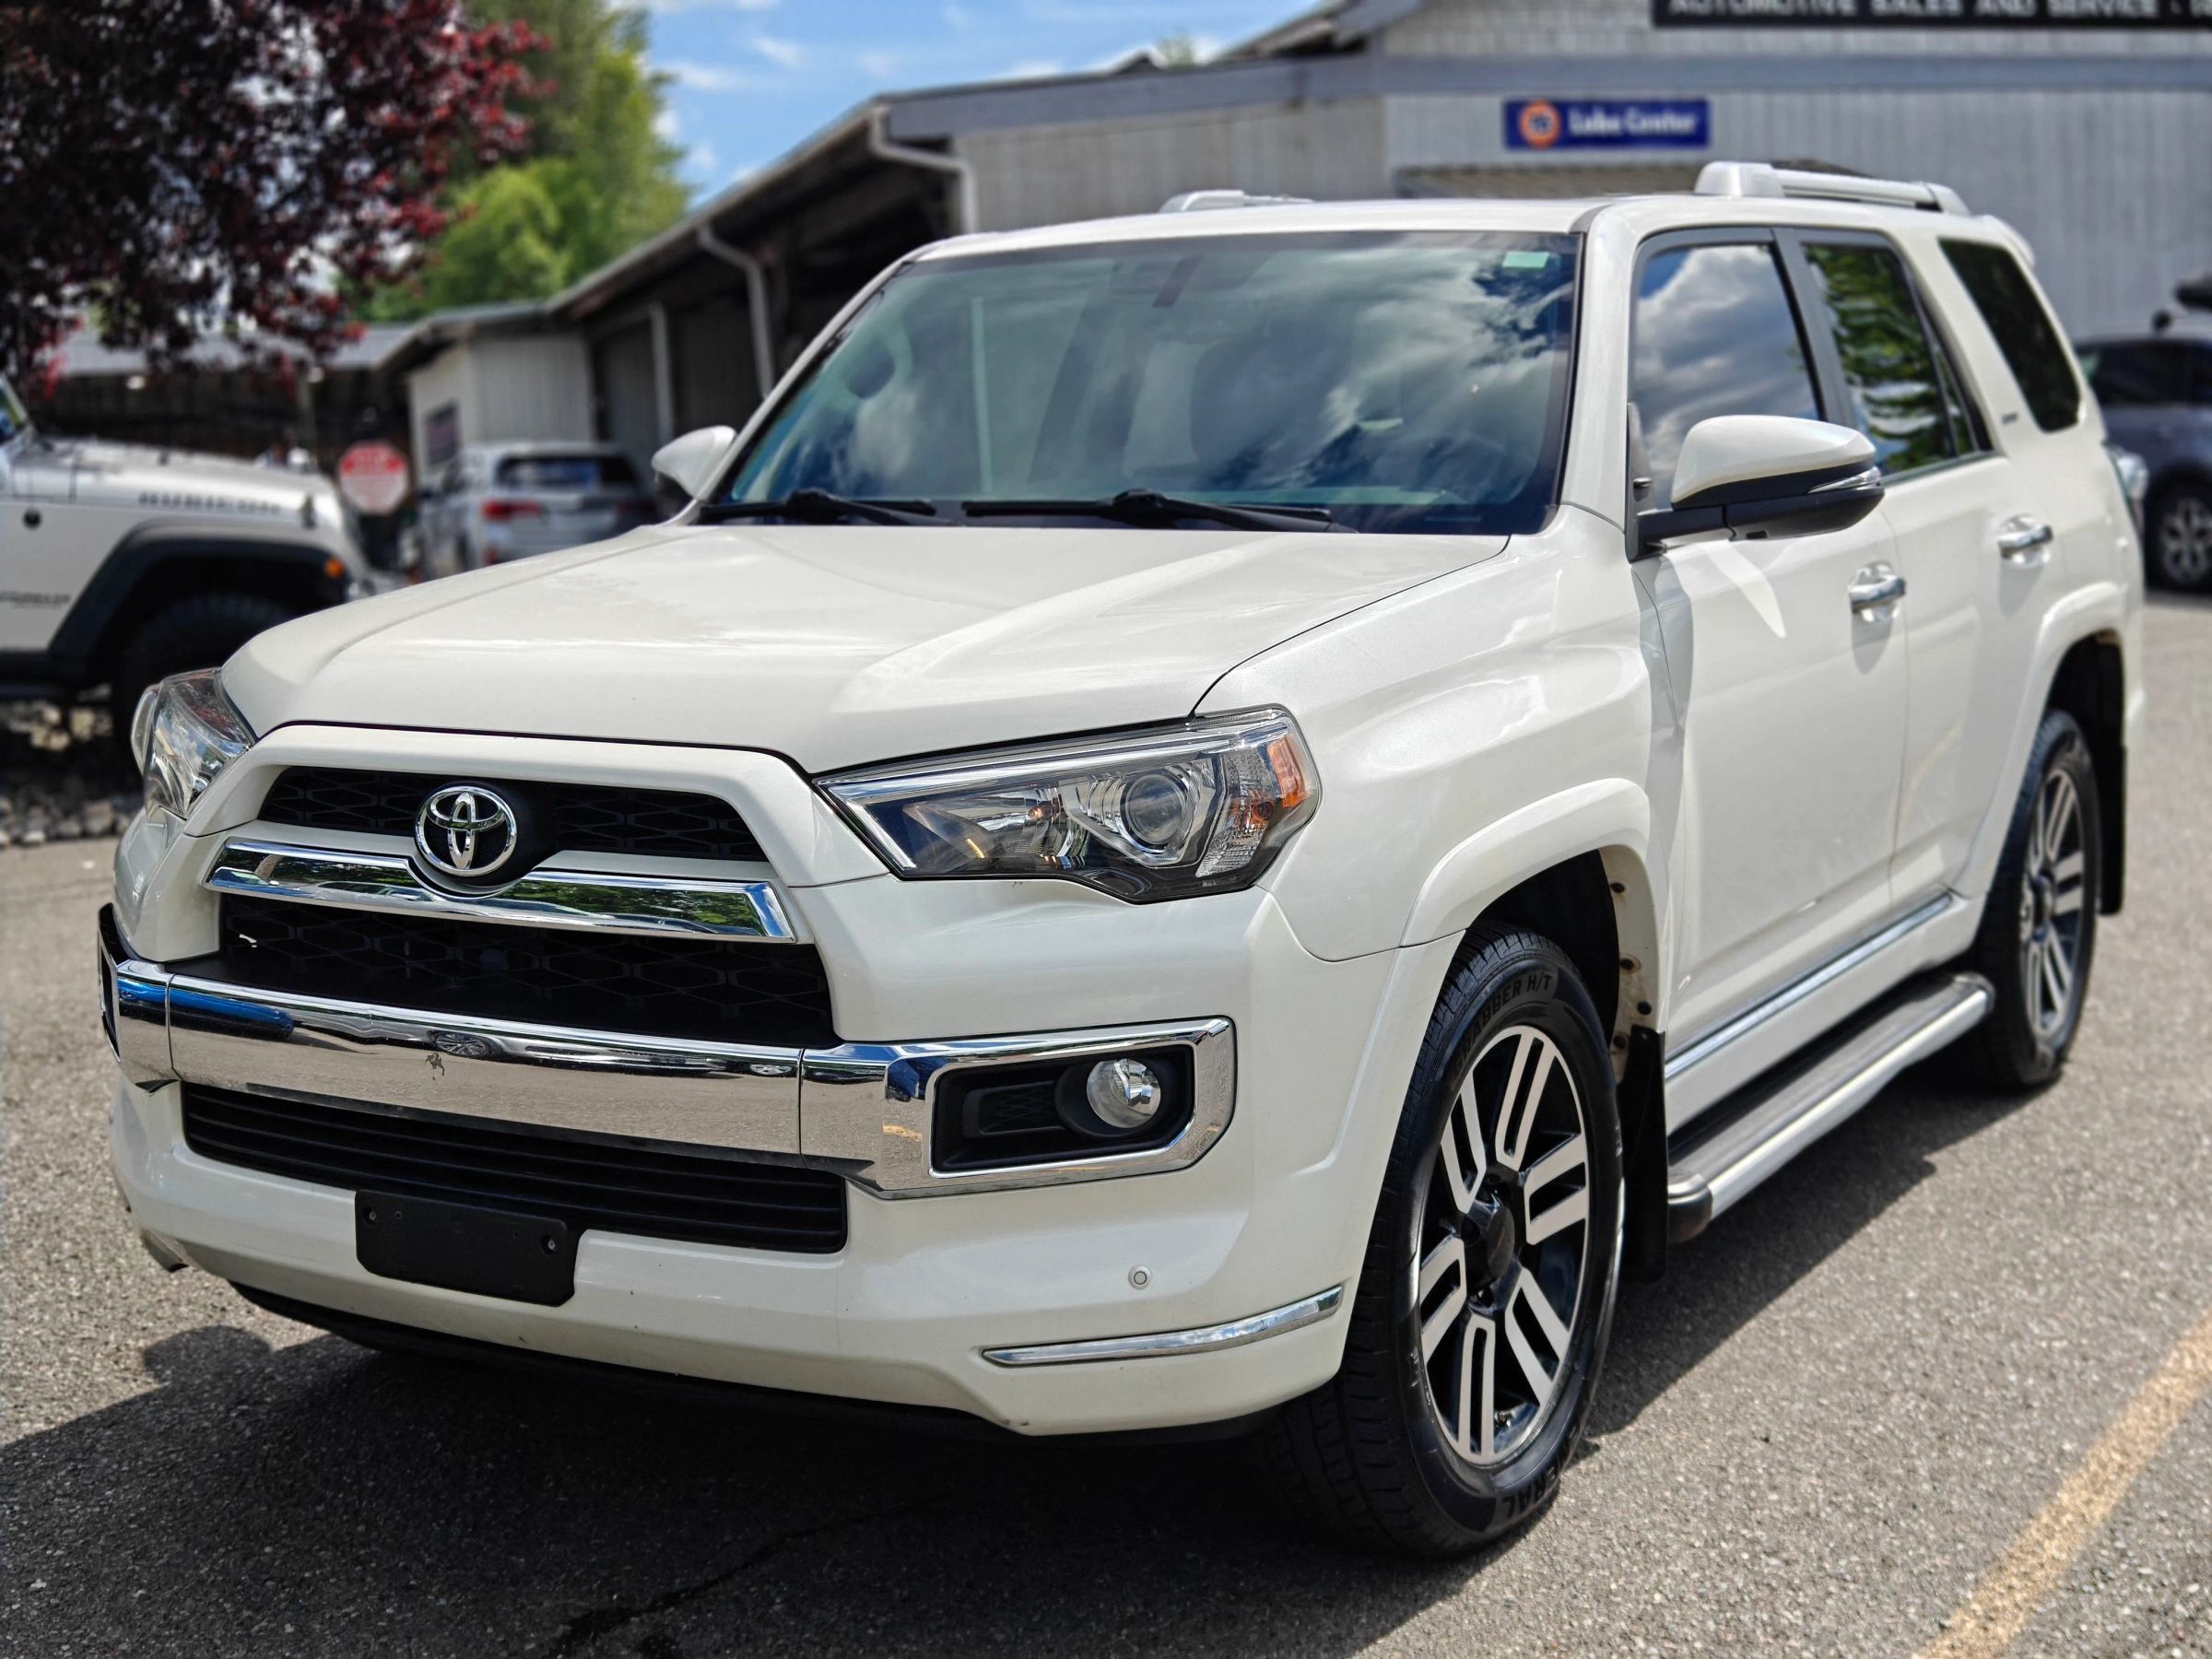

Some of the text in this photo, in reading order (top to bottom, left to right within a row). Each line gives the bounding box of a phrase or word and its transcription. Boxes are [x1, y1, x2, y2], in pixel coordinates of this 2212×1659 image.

[1667, 0, 2158, 17] AUTOMOTIVE SALES AND SERVICE
[1526, 972, 1553, 991] H/T
